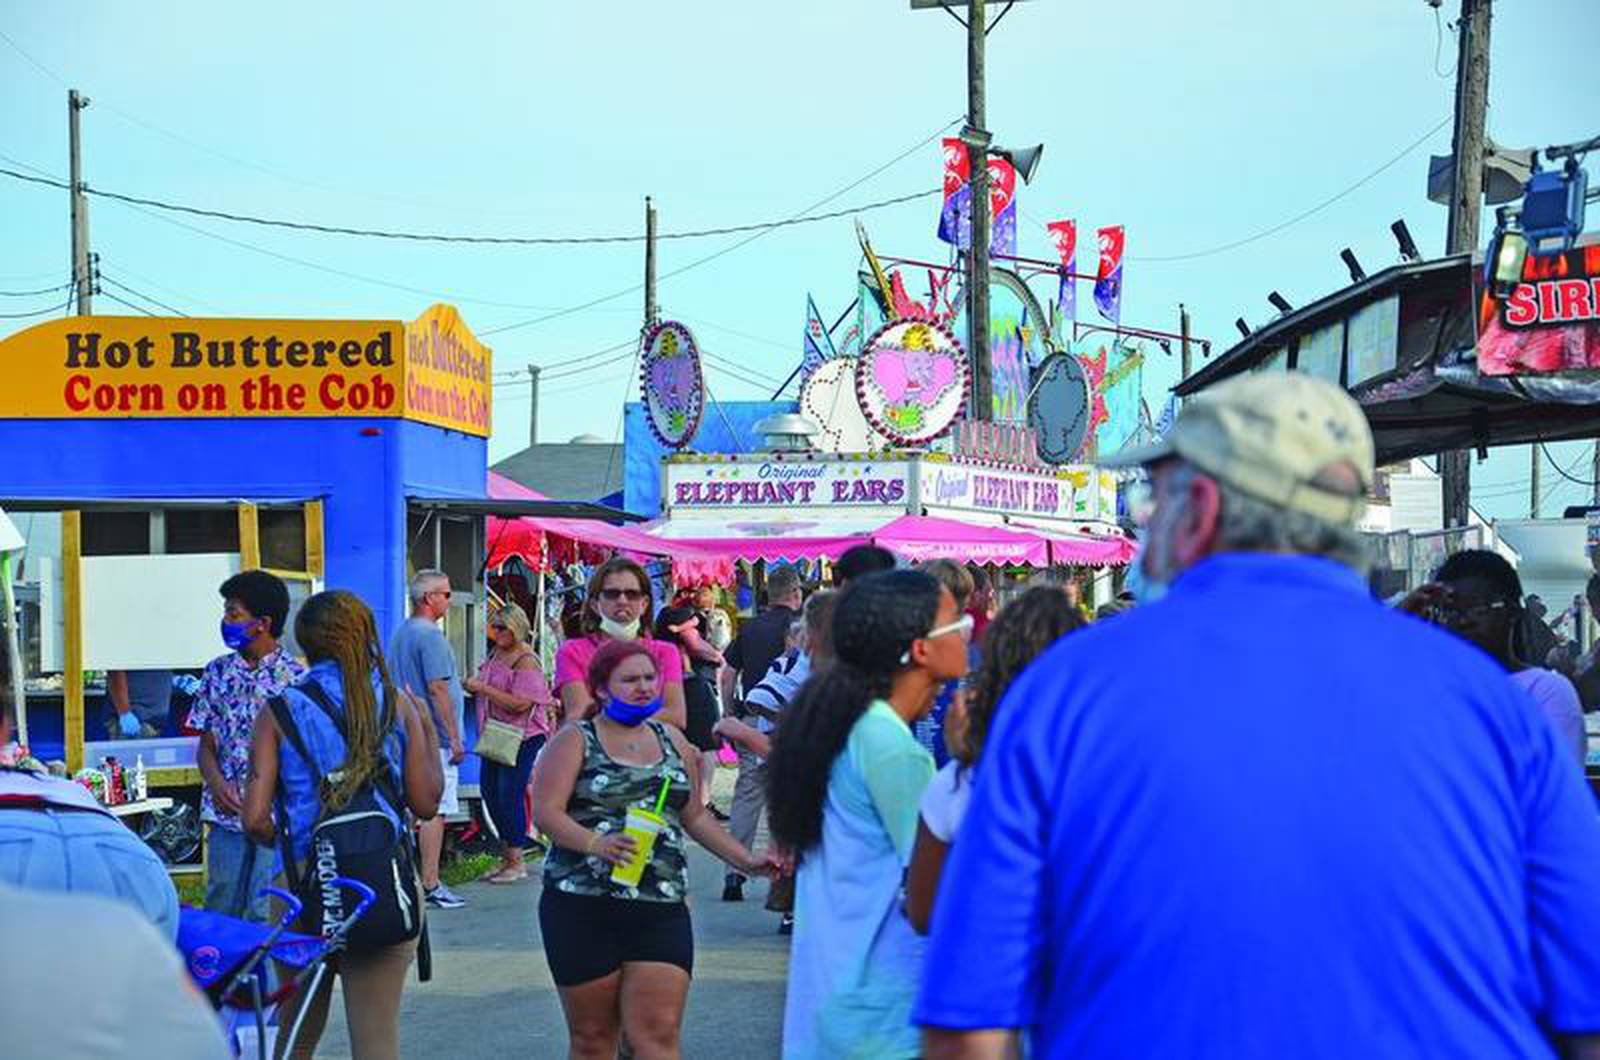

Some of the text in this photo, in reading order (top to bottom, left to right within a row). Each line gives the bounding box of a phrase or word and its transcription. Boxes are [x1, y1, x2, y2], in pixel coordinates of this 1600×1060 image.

[64, 331, 395, 368] Hot Buttered
[408, 319, 485, 384] Hot Buttered
[64, 373, 395, 412] Corn on the Cob
[407, 369, 433, 413] Corn
[449, 385, 468, 423] the
[469, 387, 488, 429] Cob
[757, 463, 827, 480] Original
[674, 479, 905, 505] ELEPHANT EARS
[973, 475, 1029, 511] ELEPHANT
[1032, 480, 1059, 513] EARS
